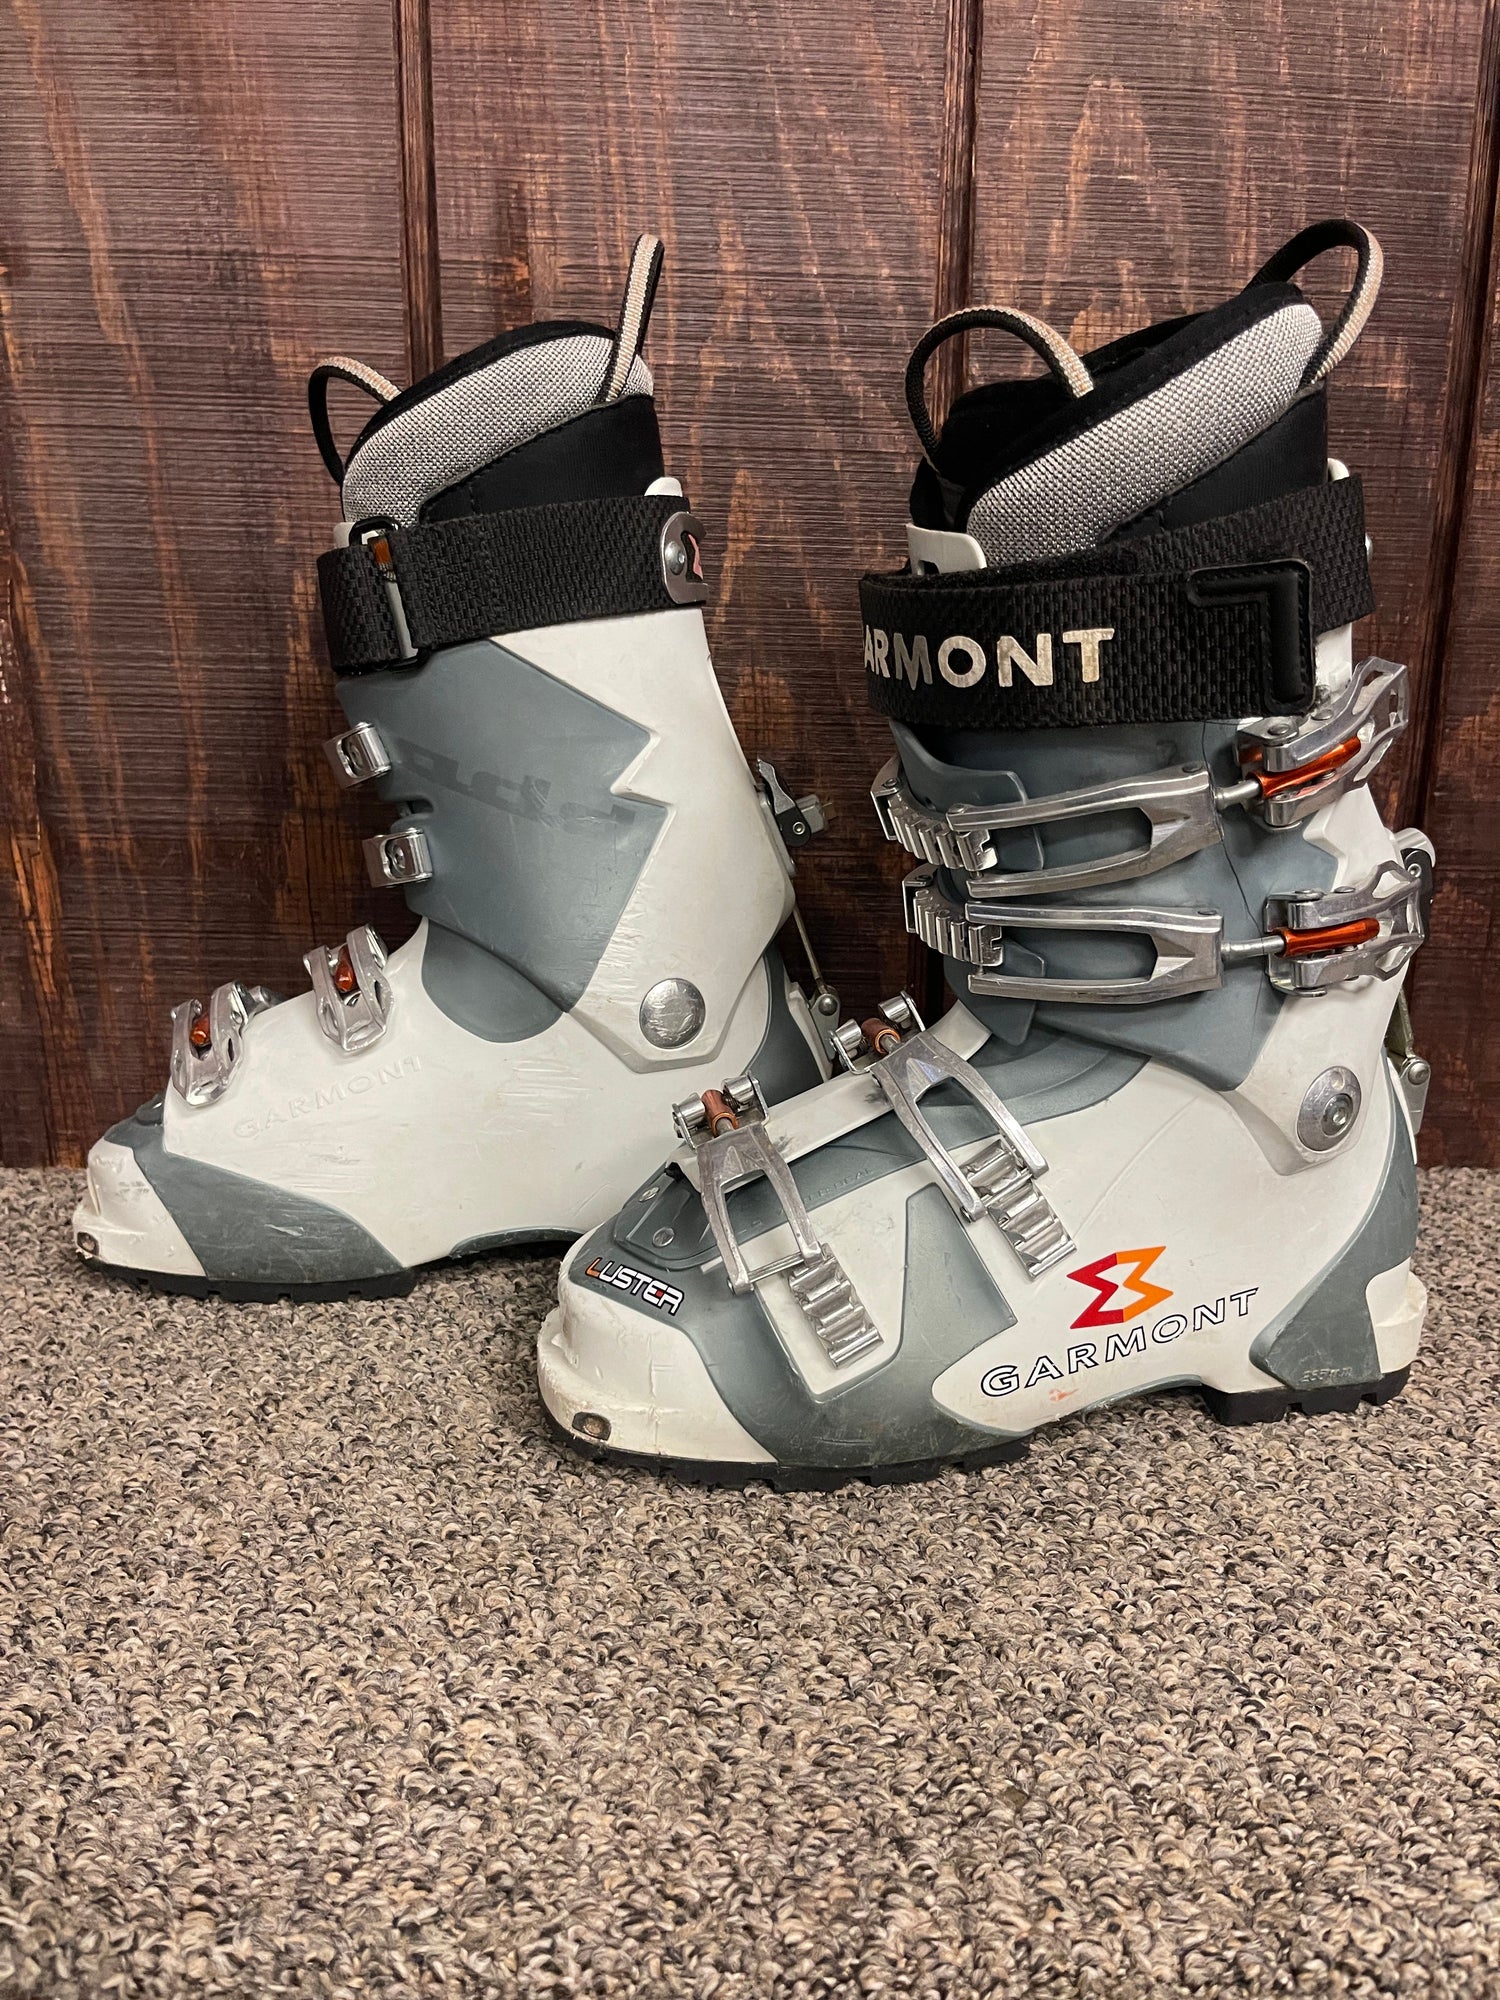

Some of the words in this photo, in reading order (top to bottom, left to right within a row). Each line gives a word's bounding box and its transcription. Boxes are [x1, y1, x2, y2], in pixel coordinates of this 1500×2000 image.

[864, 624, 1115, 690] ARMONT
[585, 1257, 685, 1316] LUSTER
[980, 1286, 1259, 1397] GARMONT
